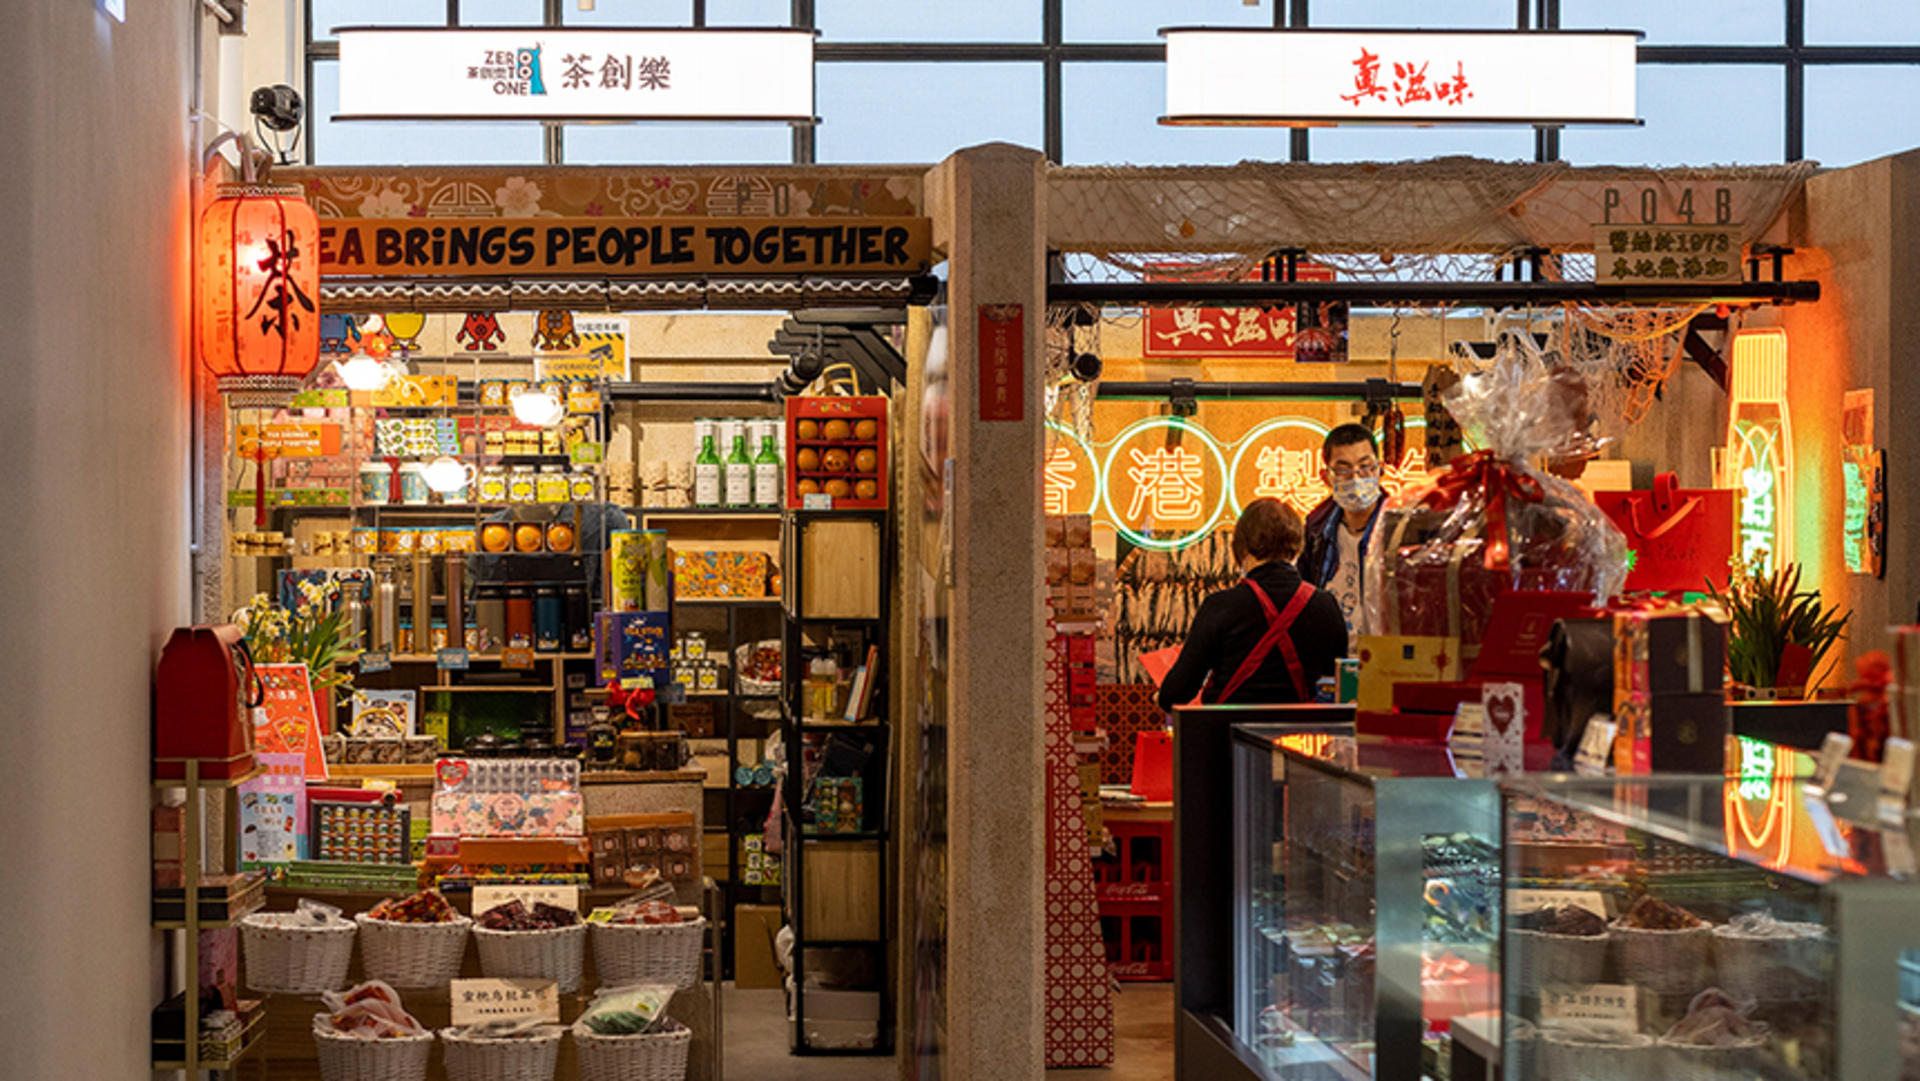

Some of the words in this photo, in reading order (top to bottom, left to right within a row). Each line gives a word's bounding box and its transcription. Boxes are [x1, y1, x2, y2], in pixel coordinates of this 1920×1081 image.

[493, 81, 528, 96] ONE
[561, 53, 671, 91] 茶創樂
[1605, 188, 1731, 224] P04B
[318, 228, 365, 265] EA
[546, 226, 695, 266] PEOPLE
[705, 225, 909, 265] TOGETHER
[244, 229, 316, 338] 茶
